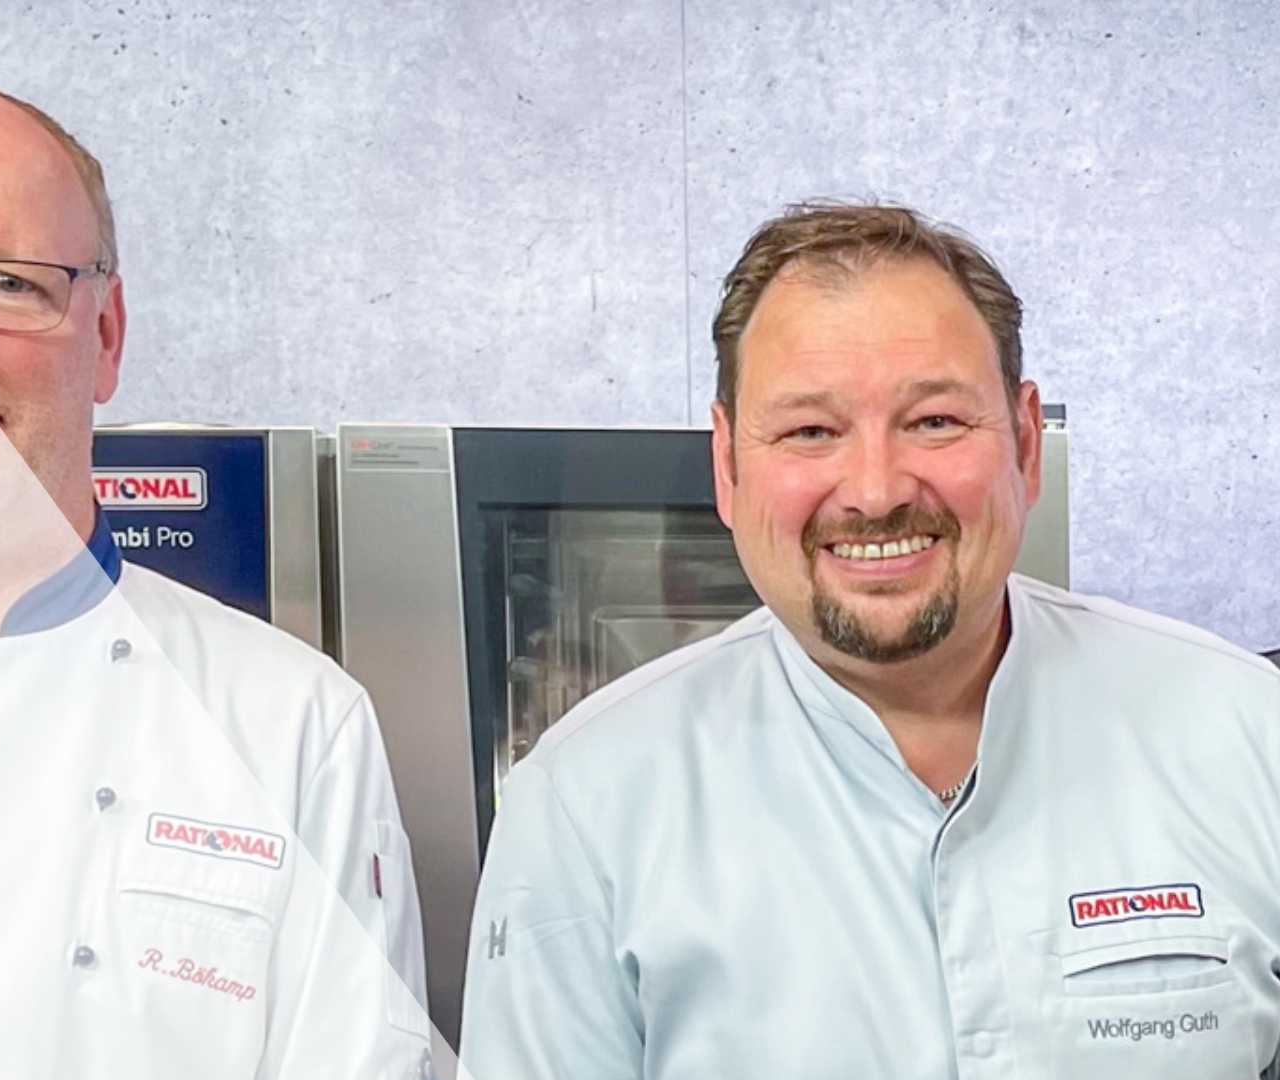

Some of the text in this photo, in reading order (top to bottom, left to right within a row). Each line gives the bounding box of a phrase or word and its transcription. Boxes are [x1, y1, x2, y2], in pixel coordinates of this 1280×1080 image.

[94, 477, 197, 499] TIONAL
[157, 526, 194, 548] Pro
[154, 819, 279, 862] RATIONAL
[1076, 891, 1198, 921] RATIONAL
[1087, 1010, 1219, 1042] Wolfgang Guth
